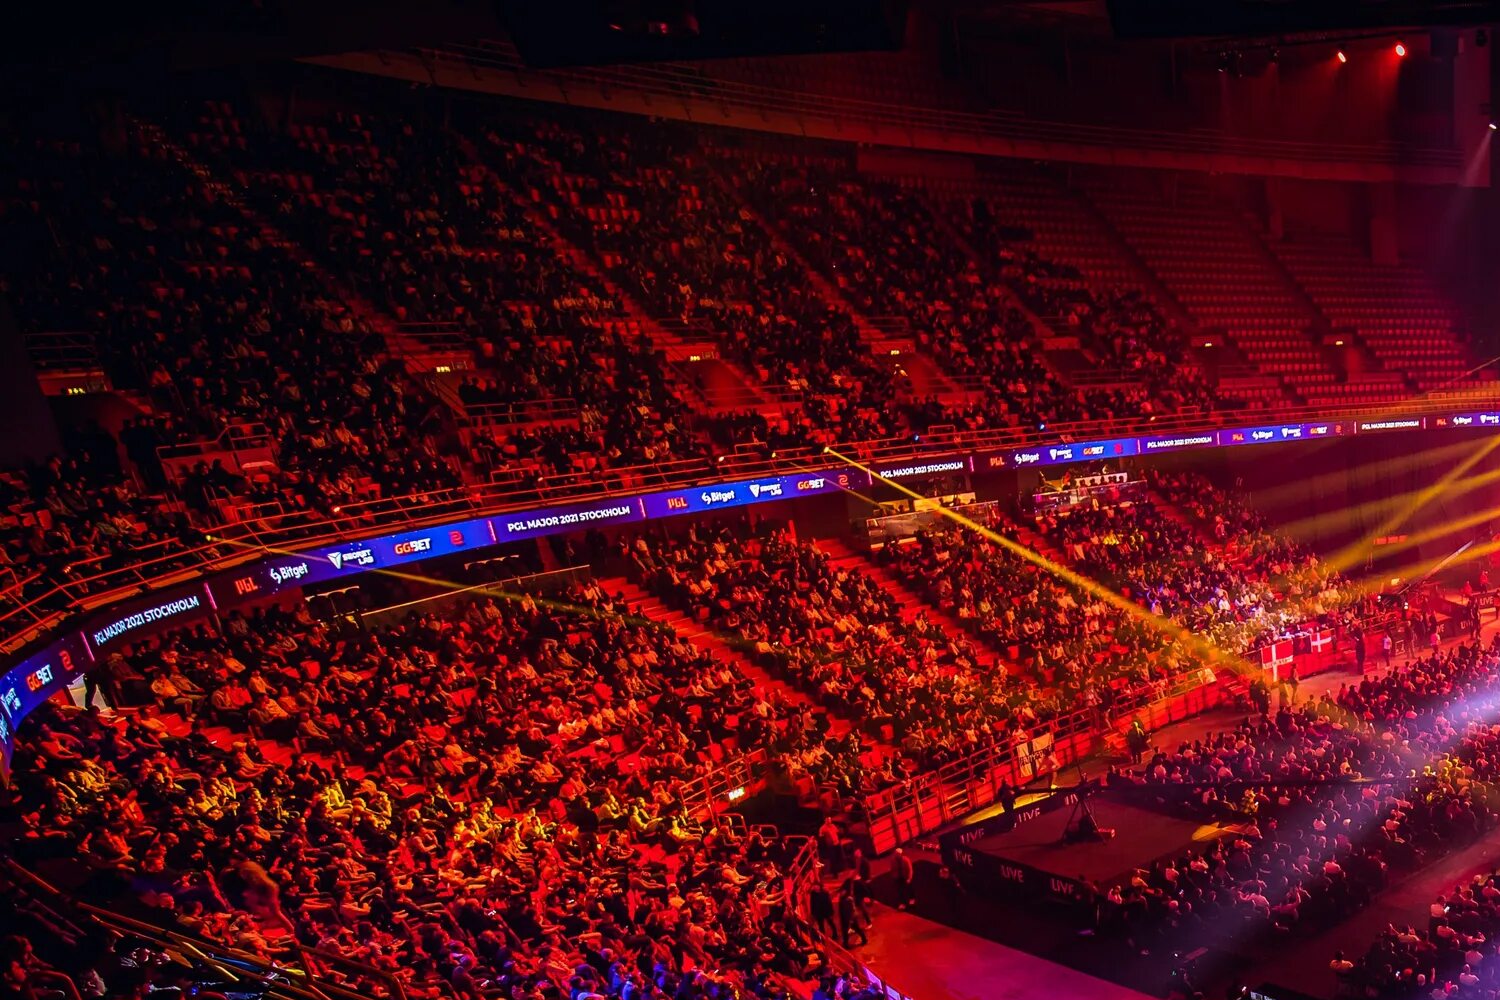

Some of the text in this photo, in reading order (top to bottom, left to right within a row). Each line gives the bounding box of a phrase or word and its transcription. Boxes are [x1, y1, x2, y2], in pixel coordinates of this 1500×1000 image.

[667, 497, 687, 509] PGL
[711, 490, 735, 503] Bitget
[507, 505, 631, 532] PGL MAJOR 2021 STOCKHOLM
[279, 562, 309, 581] Bitget
[234, 576, 259, 595] PGL
[94, 595, 200, 646] PGL MAJOR 2021 STOCKHOLM
[1001, 864, 1024, 883] LIVE
